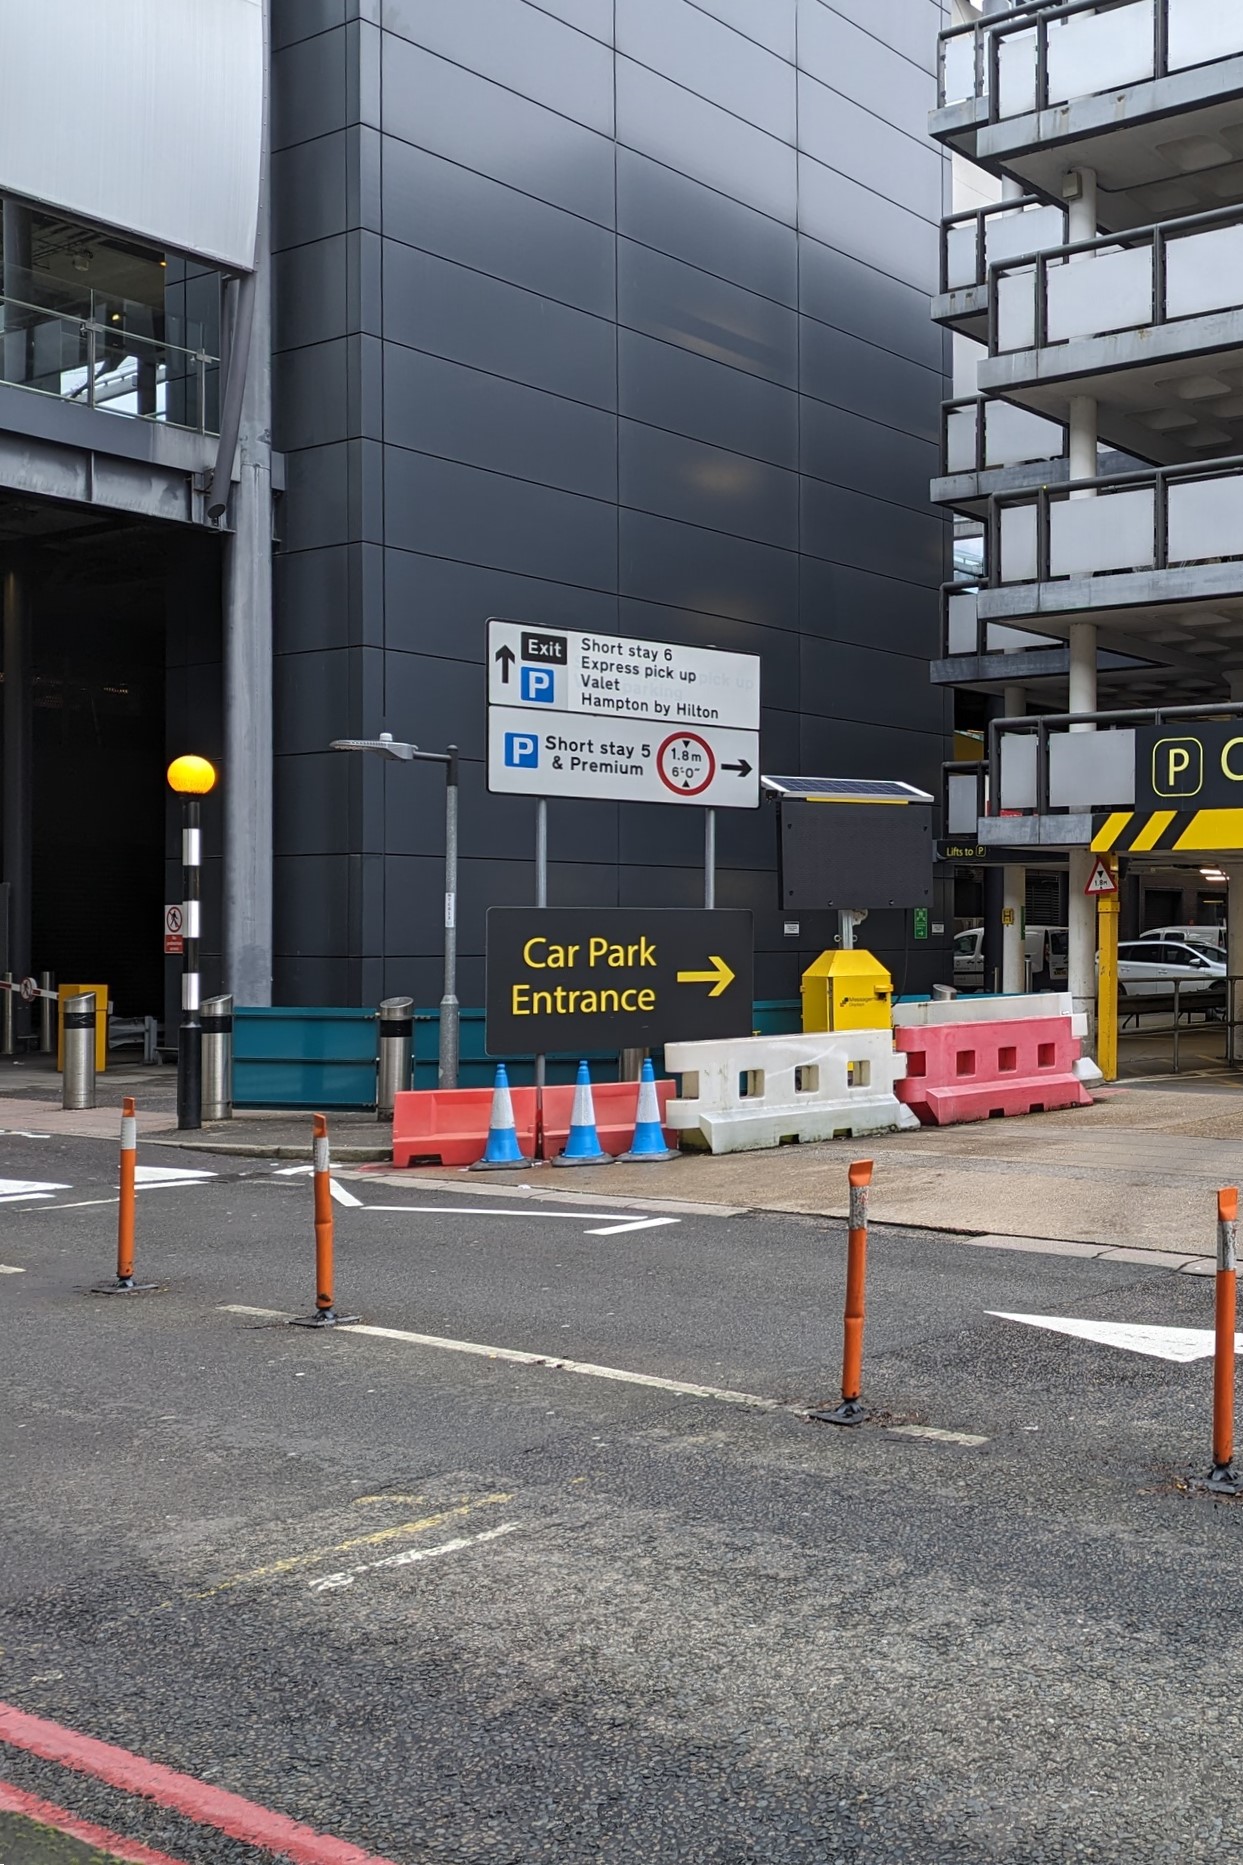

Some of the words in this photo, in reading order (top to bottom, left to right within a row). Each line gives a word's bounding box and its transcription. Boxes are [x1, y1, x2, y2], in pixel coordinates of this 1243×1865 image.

[528, 639, 561, 657] Exit
[581, 638, 623, 655] Short
[628, 645, 658, 662] stay
[664, 649, 673, 661] 6
[581, 656, 640, 675] Express
[645, 665, 674, 679] pick
[679, 671, 697, 684] up
[581, 674, 620, 691] Valet
[529, 671, 549, 698] P
[581, 692, 648, 712] Hampton
[654, 700, 670, 716] by
[677, 703, 719, 719] Hilton
[513, 737, 533, 764] P
[545, 735, 594, 753] Short
[600, 741, 635, 759] stay
[641, 744, 651, 758] 5
[552, 755, 563, 770] &
[570, 757, 644, 776] Premium
[1169, 749, 1190, 786] P
[946, 846, 963, 857] Lifts
[965, 848, 974, 856] to
[523, 937, 579, 968] Car
[589, 936, 657, 967] Park
[512, 984, 656, 1015] Entrance
